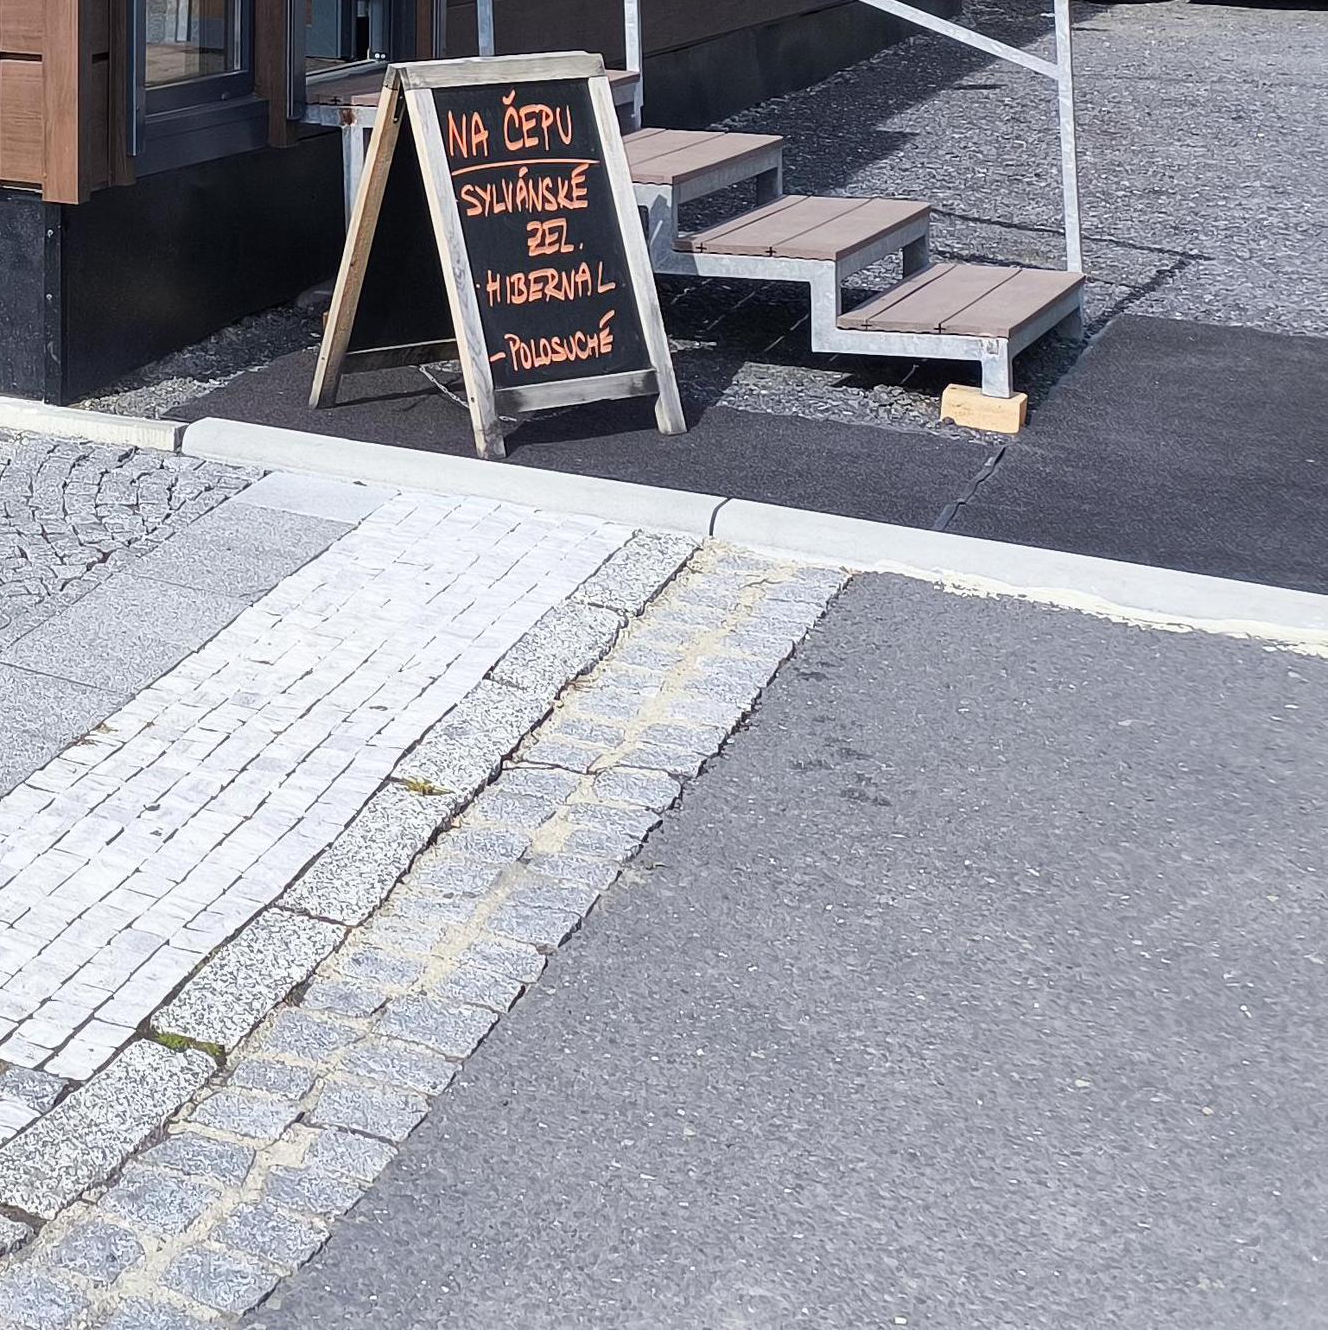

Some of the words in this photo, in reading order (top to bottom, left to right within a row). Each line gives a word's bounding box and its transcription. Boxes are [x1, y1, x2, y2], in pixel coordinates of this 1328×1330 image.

[447, 110, 489, 159] NA
[502, 89, 573, 152] ČEPU
[460, 162, 590, 218] SYLVÁNSKÉ
[485, 261, 617, 307] HIBERNAL
